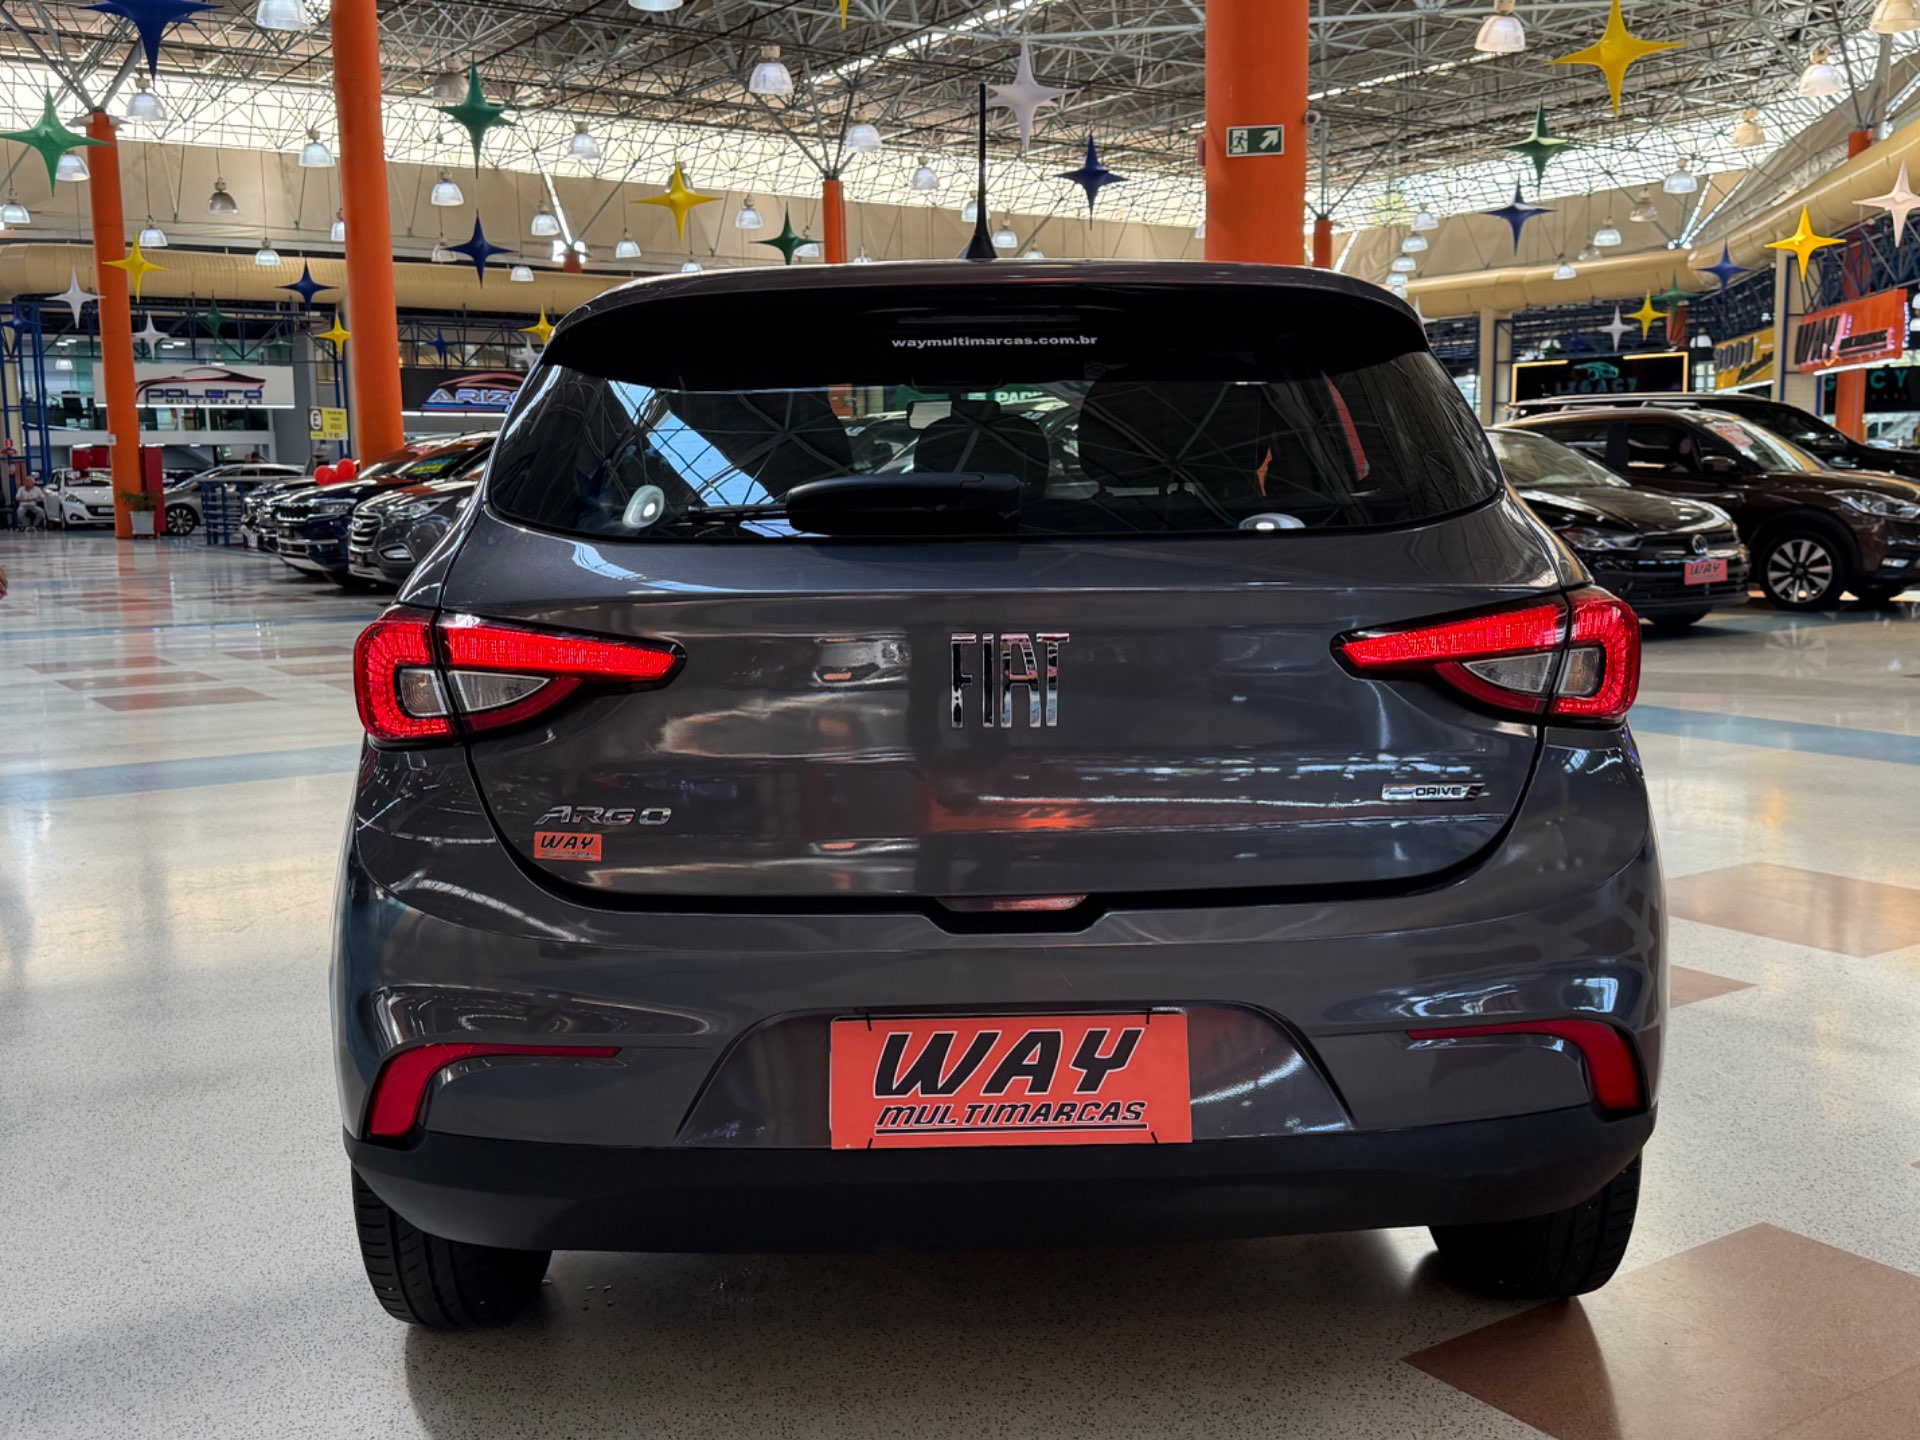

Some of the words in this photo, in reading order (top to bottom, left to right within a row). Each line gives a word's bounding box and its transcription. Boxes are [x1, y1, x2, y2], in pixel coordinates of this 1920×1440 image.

[891, 335, 1098, 349] waymultimarcas.com.br
[1555, 376, 1639, 395] LEGACY
[1691, 561, 1722, 575] WAY
[951, 632, 1070, 728] FIAT
[1415, 787, 1463, 797] DRIVE
[534, 805, 673, 826] ARGO
[540, 834, 595, 849] WAY
[873, 1027, 1145, 1099] WAY
[875, 1101, 1148, 1127] MULTIMARCAS
